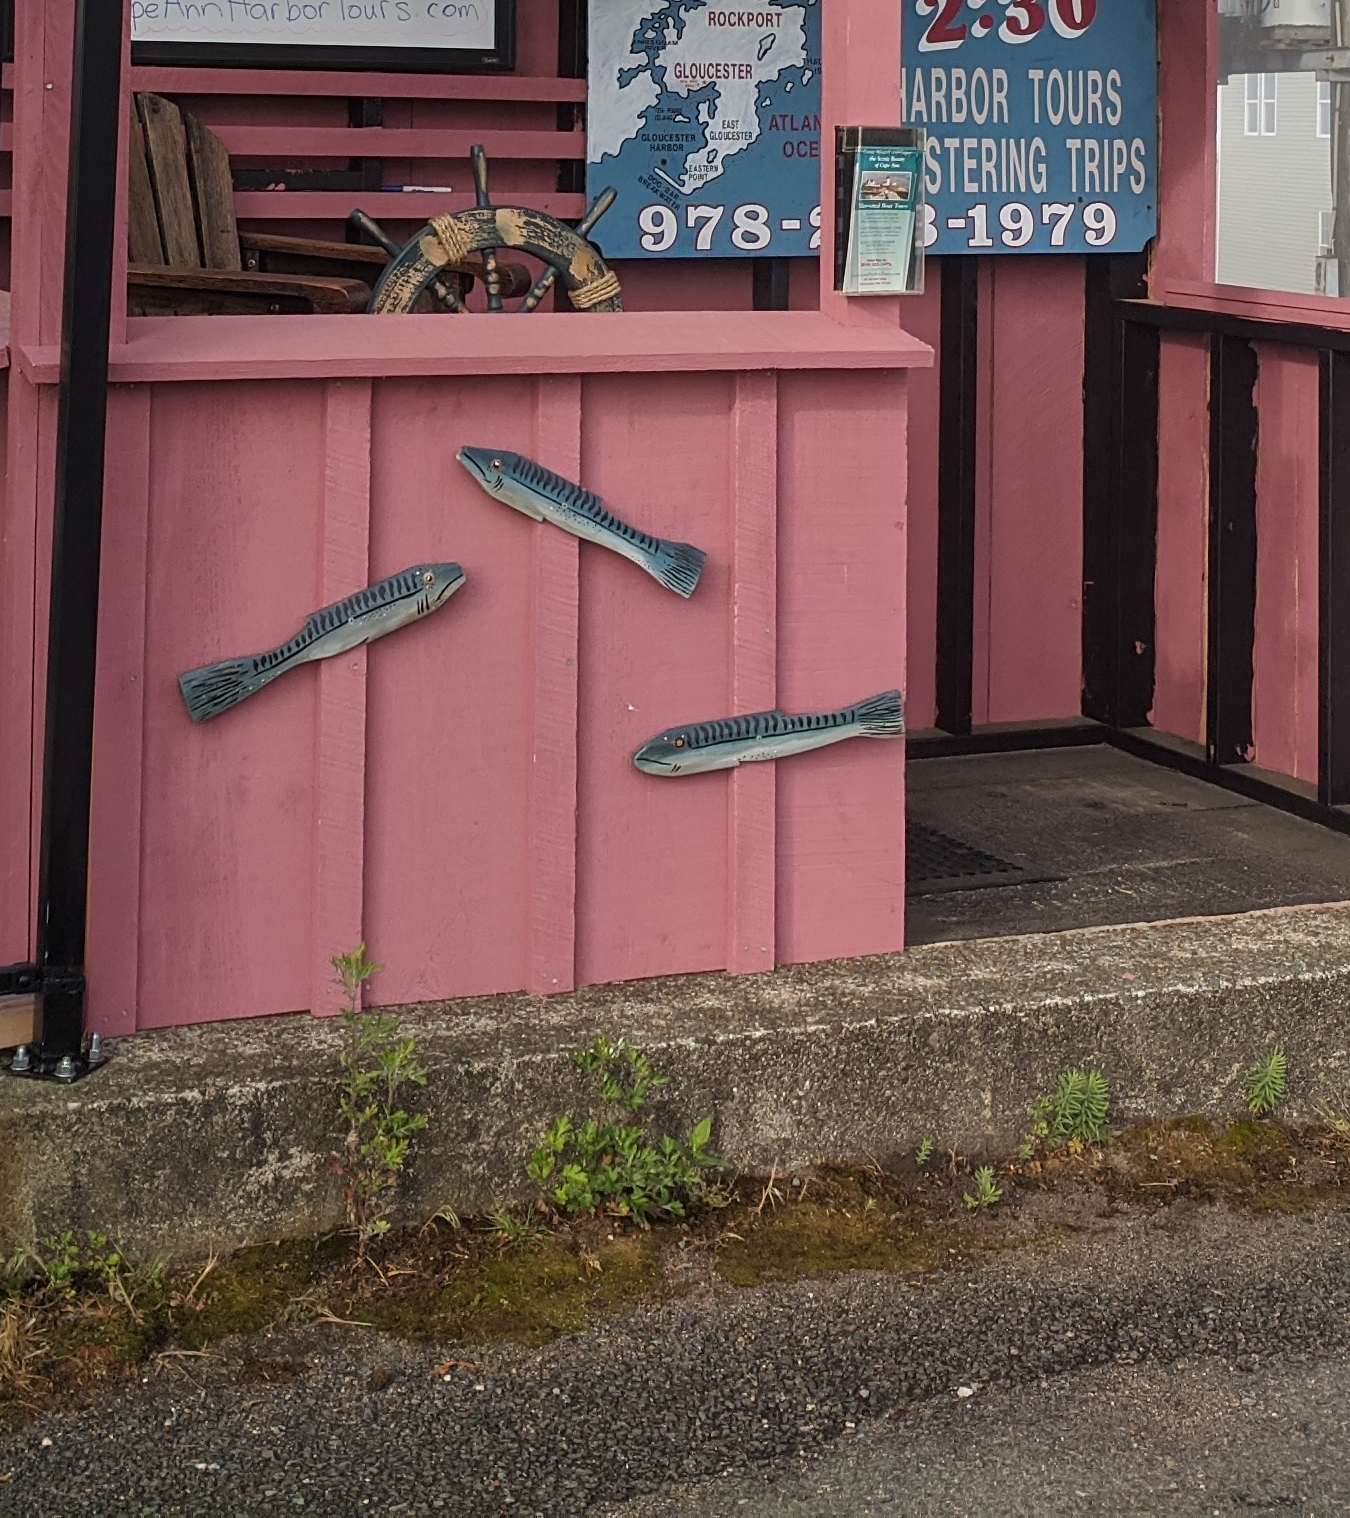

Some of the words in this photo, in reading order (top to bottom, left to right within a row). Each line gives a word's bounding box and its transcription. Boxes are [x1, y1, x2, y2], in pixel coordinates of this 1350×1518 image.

[707, 11, 782, 28] ROCKPORT
[674, 62, 753, 80] GLOUCESTER
[1028, 68, 1122, 126] TOURS
[722, 120, 739, 130] EAST
[768, 114, 822, 131] ATLAN
[641, 134, 696, 142] GLOUCESTER
[709, 131, 753, 141] GLOUCESTER
[650, 143, 684, 152] HARBOR
[783, 140, 819, 158] OCE
[688, 164, 719, 172] EASTERN
[924, 137, 1048, 195] STERING
[1065, 137, 1146, 195] TRIPS
[688, 173, 709, 181] POINT
[647, 173, 663, 188] DOG
[664, 187, 679, 201] BAR
[637, 200, 1118, 253] 978--1979
